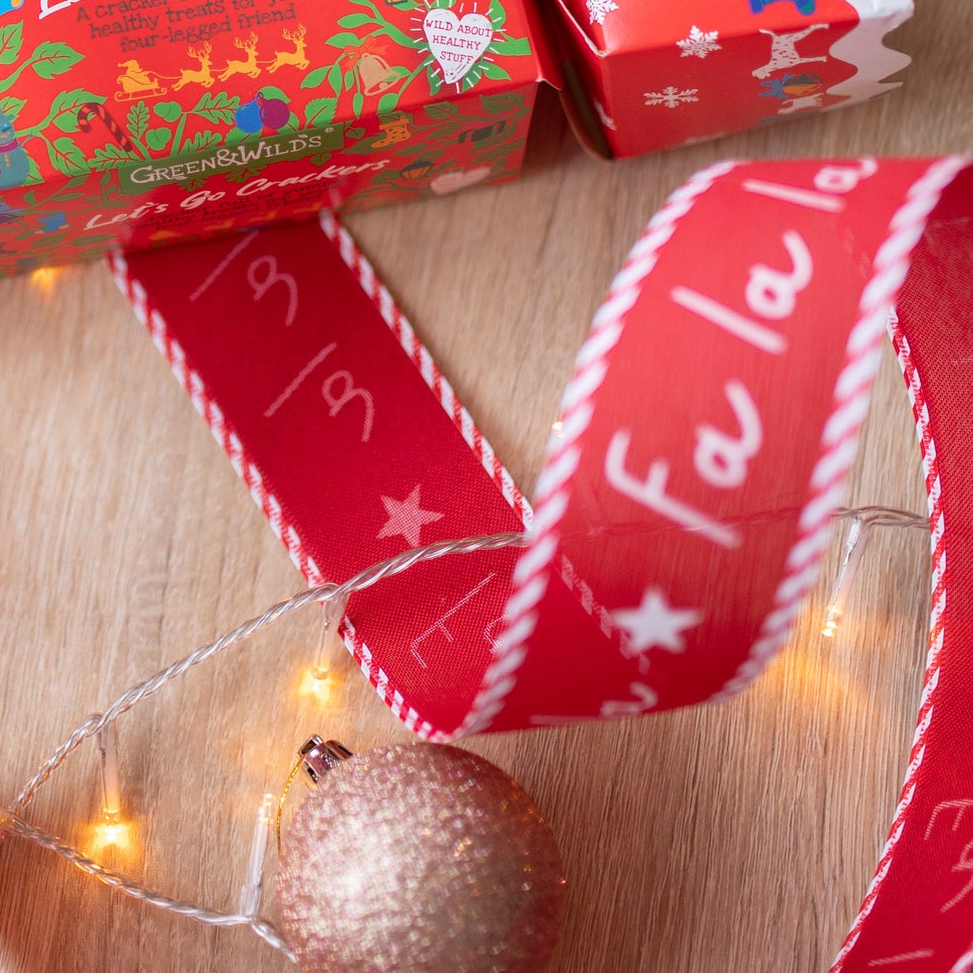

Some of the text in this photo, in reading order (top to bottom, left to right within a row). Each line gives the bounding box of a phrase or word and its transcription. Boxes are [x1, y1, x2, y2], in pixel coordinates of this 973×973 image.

[77, 6, 90, 23] A
[89, 13, 160, 39] healthy
[120, 2, 297, 53] four-legged friend
[426, 19, 492, 38] WILD ABOUT
[432, 35, 481, 50] HEALTHY
[440, 51, 474, 64] STUFF
[83, 202, 169, 231] Let's
[180, 190, 226, 210] Go
[236, 159, 390, 196] Crackers
[741, 155, 879, 214] la
[670, 229, 815, 355] la
